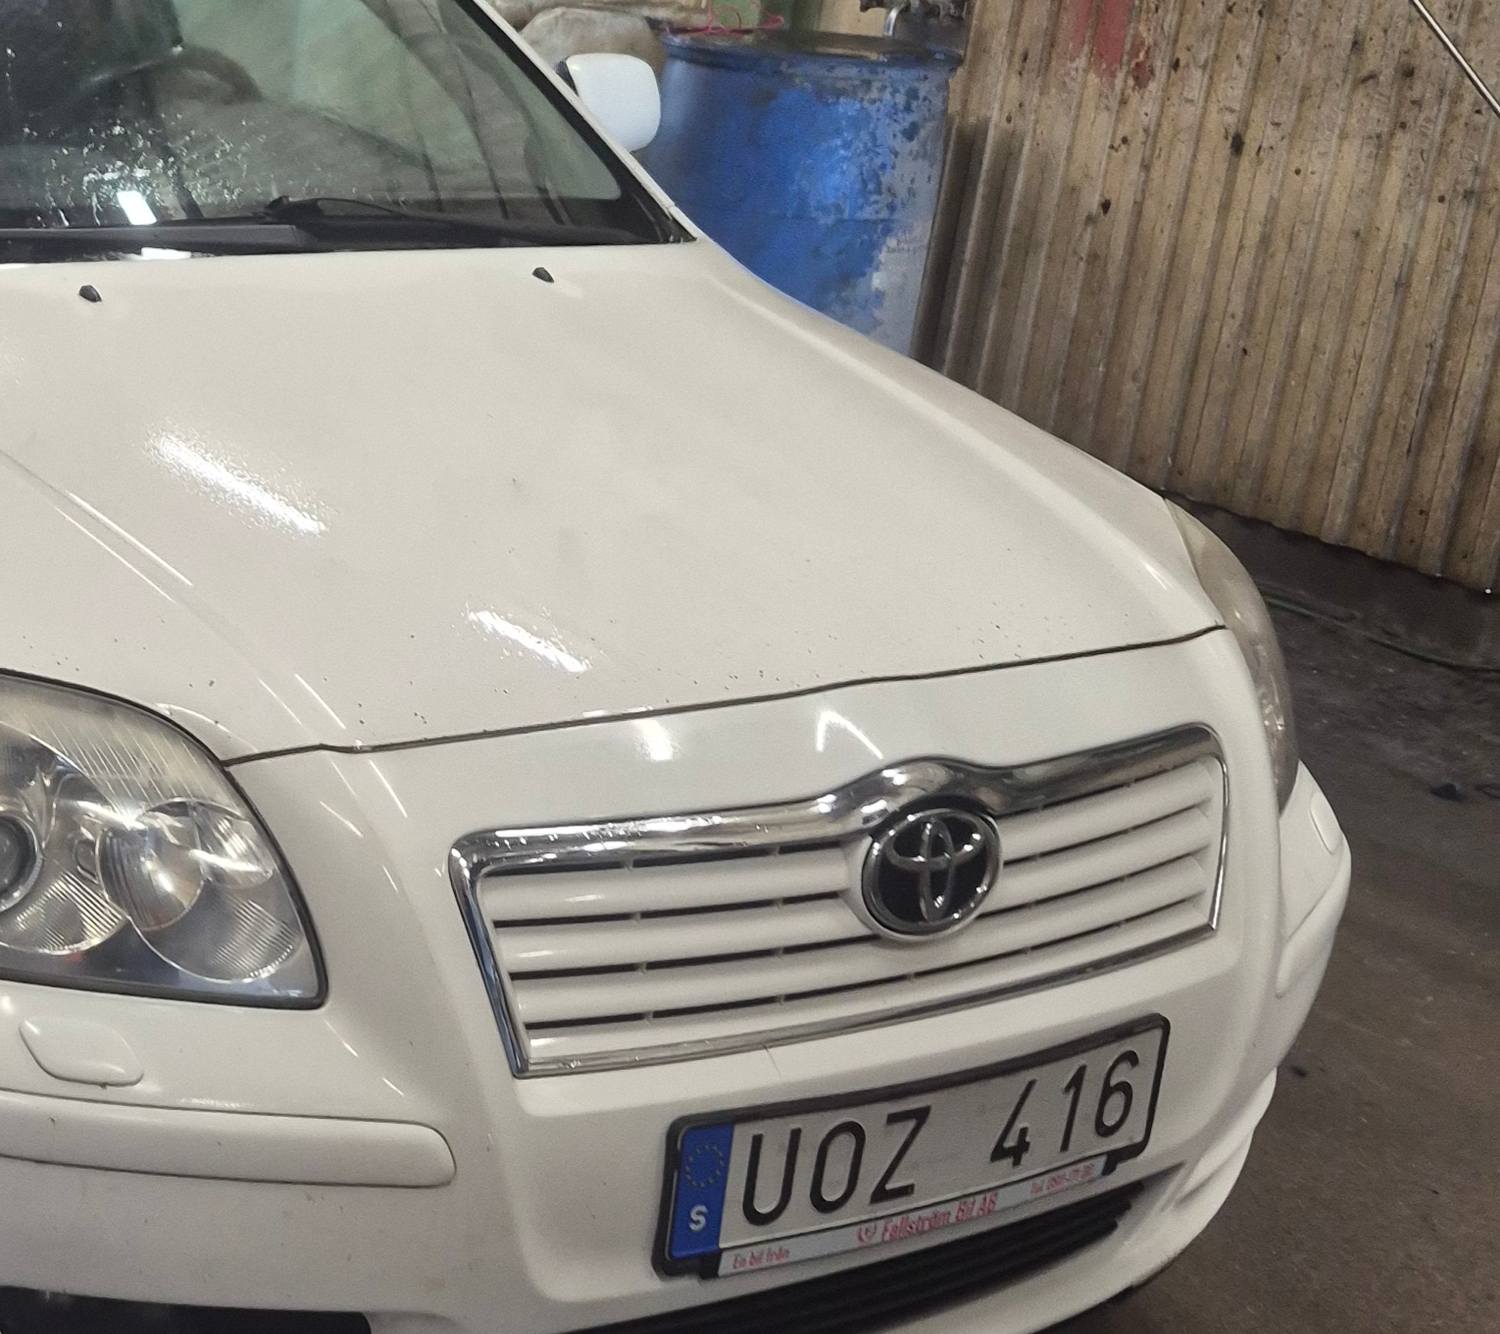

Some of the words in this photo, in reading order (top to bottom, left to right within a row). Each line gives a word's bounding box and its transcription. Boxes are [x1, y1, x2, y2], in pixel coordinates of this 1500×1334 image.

[742, 1105, 931, 1226] UOZ
[990, 1050, 1139, 1167] 416
[688, 1205, 708, 1232] S
